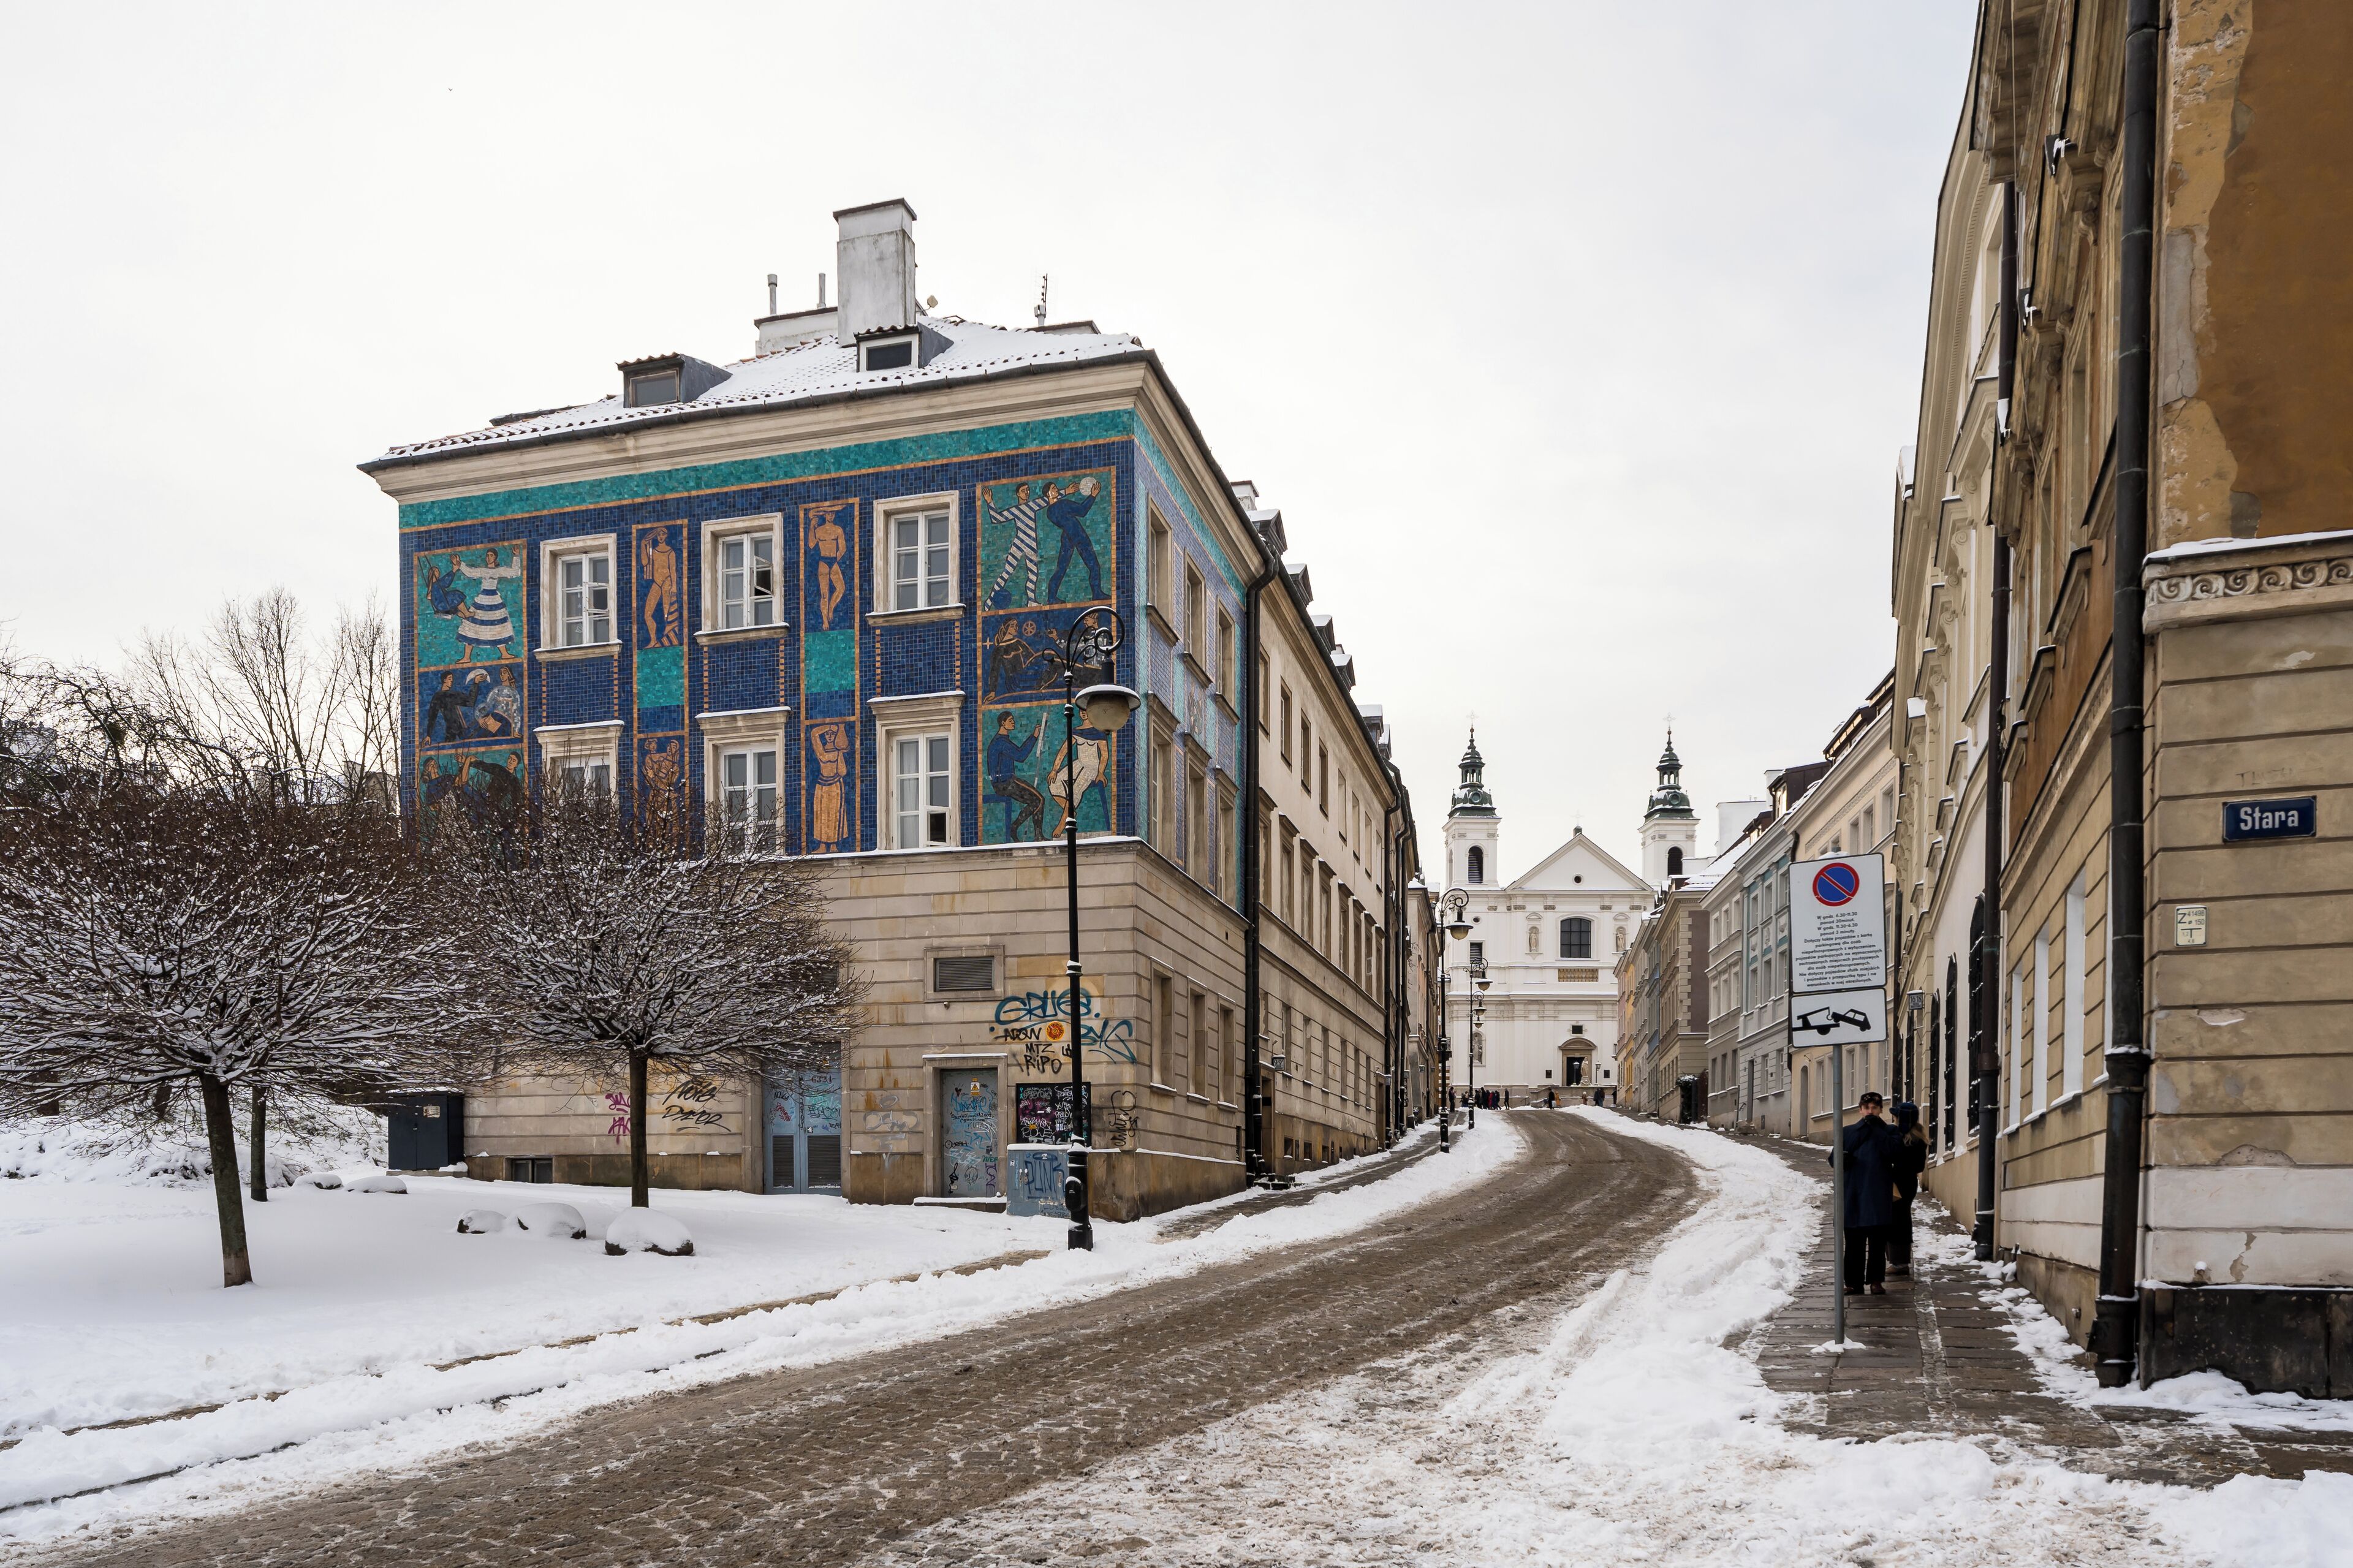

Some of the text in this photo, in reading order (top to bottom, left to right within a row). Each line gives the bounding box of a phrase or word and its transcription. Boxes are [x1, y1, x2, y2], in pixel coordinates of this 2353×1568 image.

[2240, 806, 2298, 831] Stara
[2178, 913, 2186, 923] Z
[1025, 1043, 1055, 1054] MTZ
